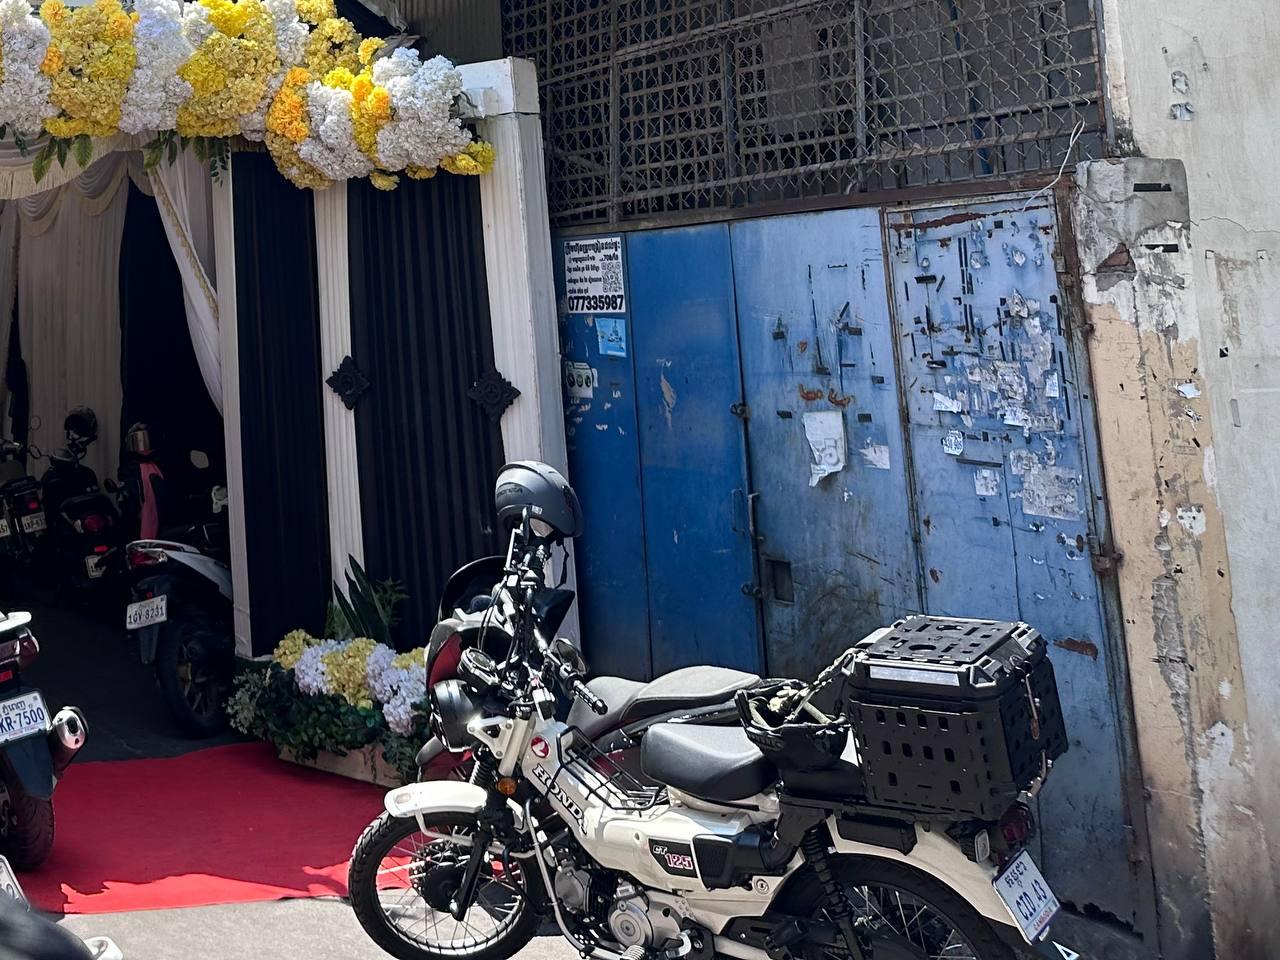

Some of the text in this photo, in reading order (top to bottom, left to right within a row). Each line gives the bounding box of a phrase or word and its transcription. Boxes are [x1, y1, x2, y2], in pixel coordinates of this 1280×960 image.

[568, 294, 624, 311] 077335987
[532, 762, 588, 836] HONDA
[653, 844, 668, 855] CT
[665, 853, 694, 870] 125
